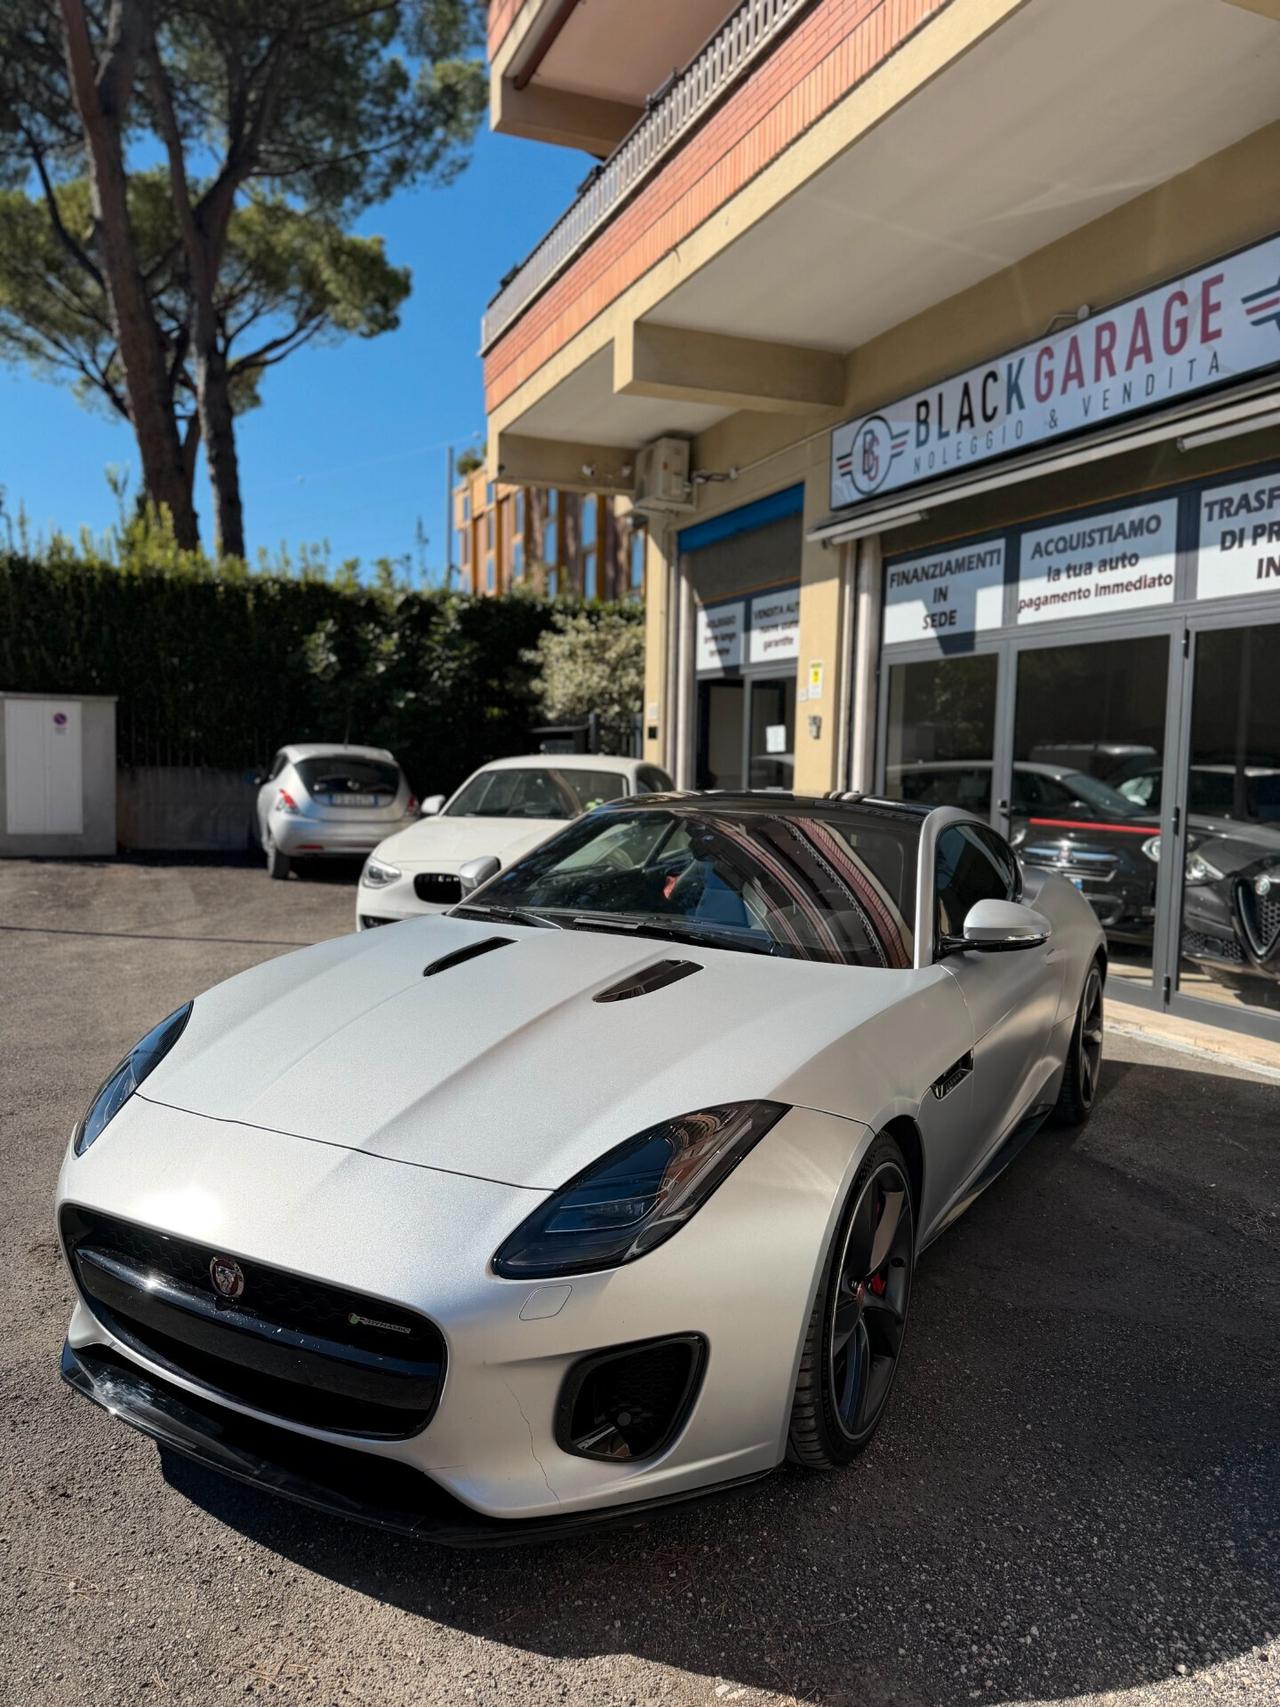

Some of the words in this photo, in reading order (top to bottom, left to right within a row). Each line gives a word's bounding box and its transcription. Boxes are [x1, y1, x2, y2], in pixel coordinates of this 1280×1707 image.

[915, 273, 1225, 448] BLACKGARAGE
[914, 420, 1023, 475] NOLEGGIO
[1048, 408, 1058, 430] &
[1082, 351, 1220, 417] VENDITA
[1204, 485, 1280, 522] TRASF
[1030, 514, 1162, 560] ACQUISTIAMO
[1220, 527, 1246, 552] DI
[1251, 520, 1280, 546] PR
[889, 547, 1002, 589] FINANZIAMENTI
[1046, 565, 1061, 583] la
[1066, 560, 1093, 580] tua
[1098, 551, 1139, 573] auto
[933, 585, 949, 604] IN
[1017, 587, 1091, 614] pagamento
[922, 608, 957, 630] SEDE
